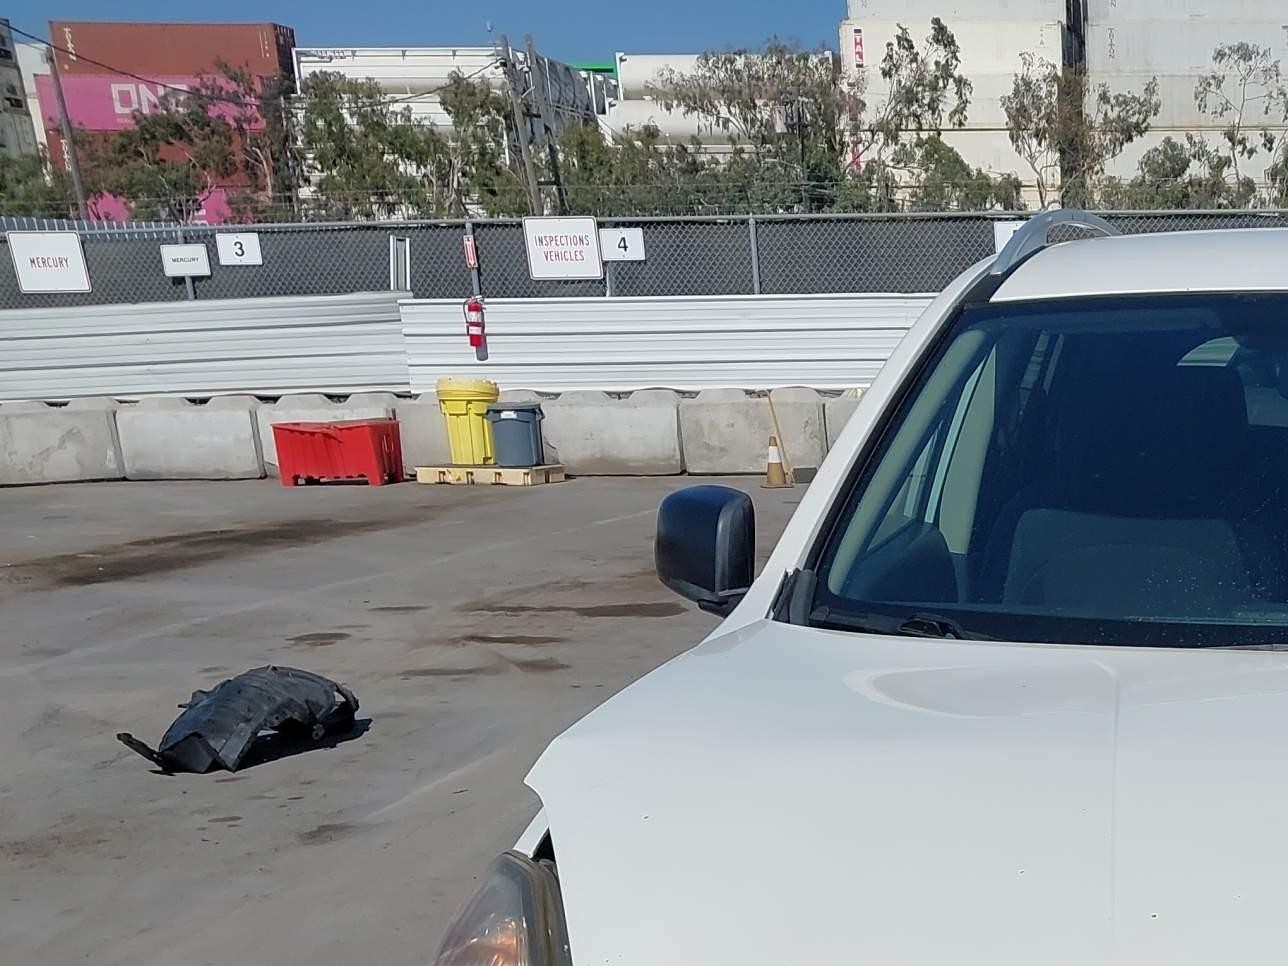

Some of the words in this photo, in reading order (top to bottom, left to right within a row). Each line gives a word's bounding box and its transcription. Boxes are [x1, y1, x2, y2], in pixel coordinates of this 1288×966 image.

[534, 234, 590, 247] INSPECTIONS
[617, 236, 629, 252] 4
[234, 241, 245, 257] 3
[29, 256, 69, 269] MERCURY
[543, 250, 585, 262] VEHICLES
